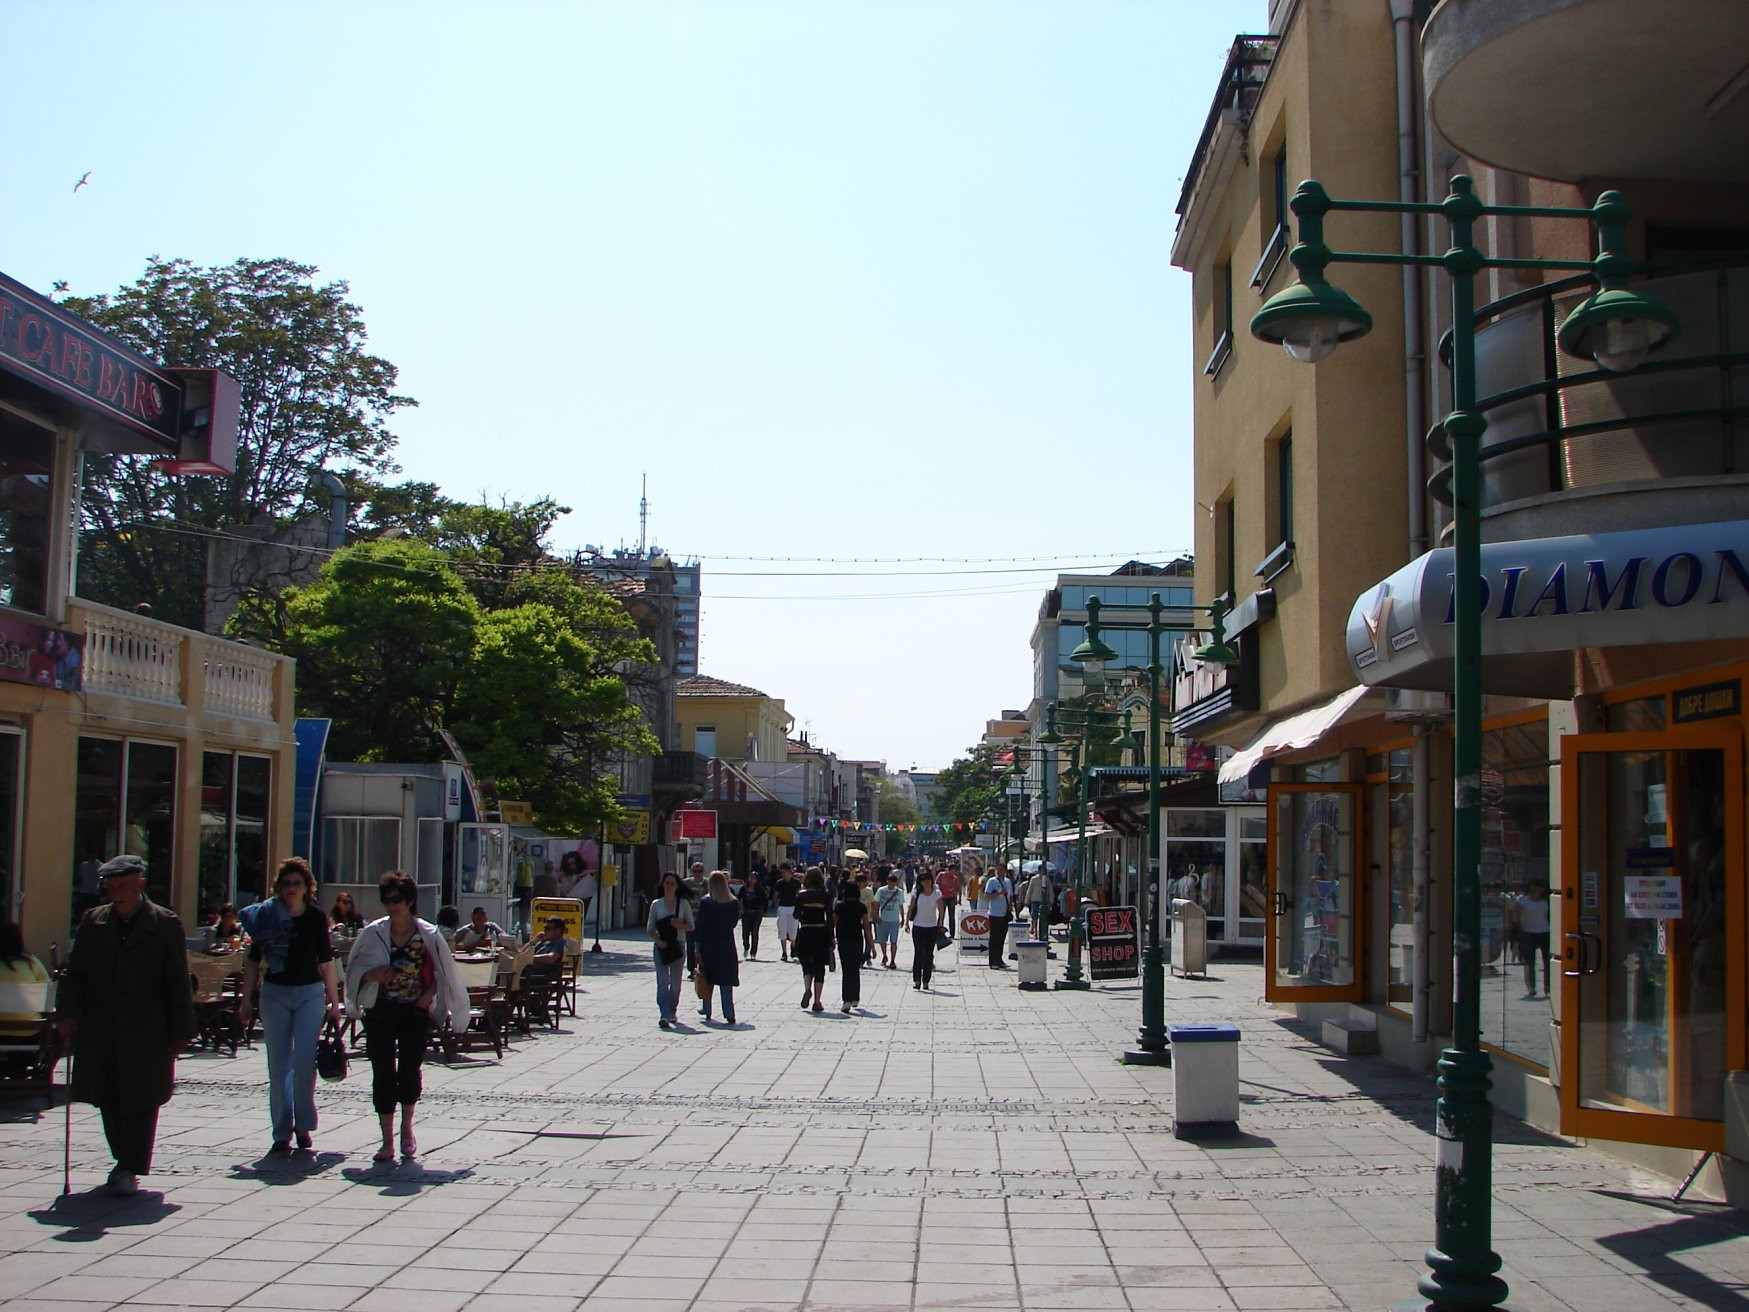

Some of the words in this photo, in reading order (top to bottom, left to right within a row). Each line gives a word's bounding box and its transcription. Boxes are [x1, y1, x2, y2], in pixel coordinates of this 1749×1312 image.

[18, 314, 94, 390] CAFE
[98, 353, 150, 420] BAR
[966, 919, 987, 930] KK
[1090, 911, 1134, 934] SEX
[1091, 945, 1135, 962] SHOP
